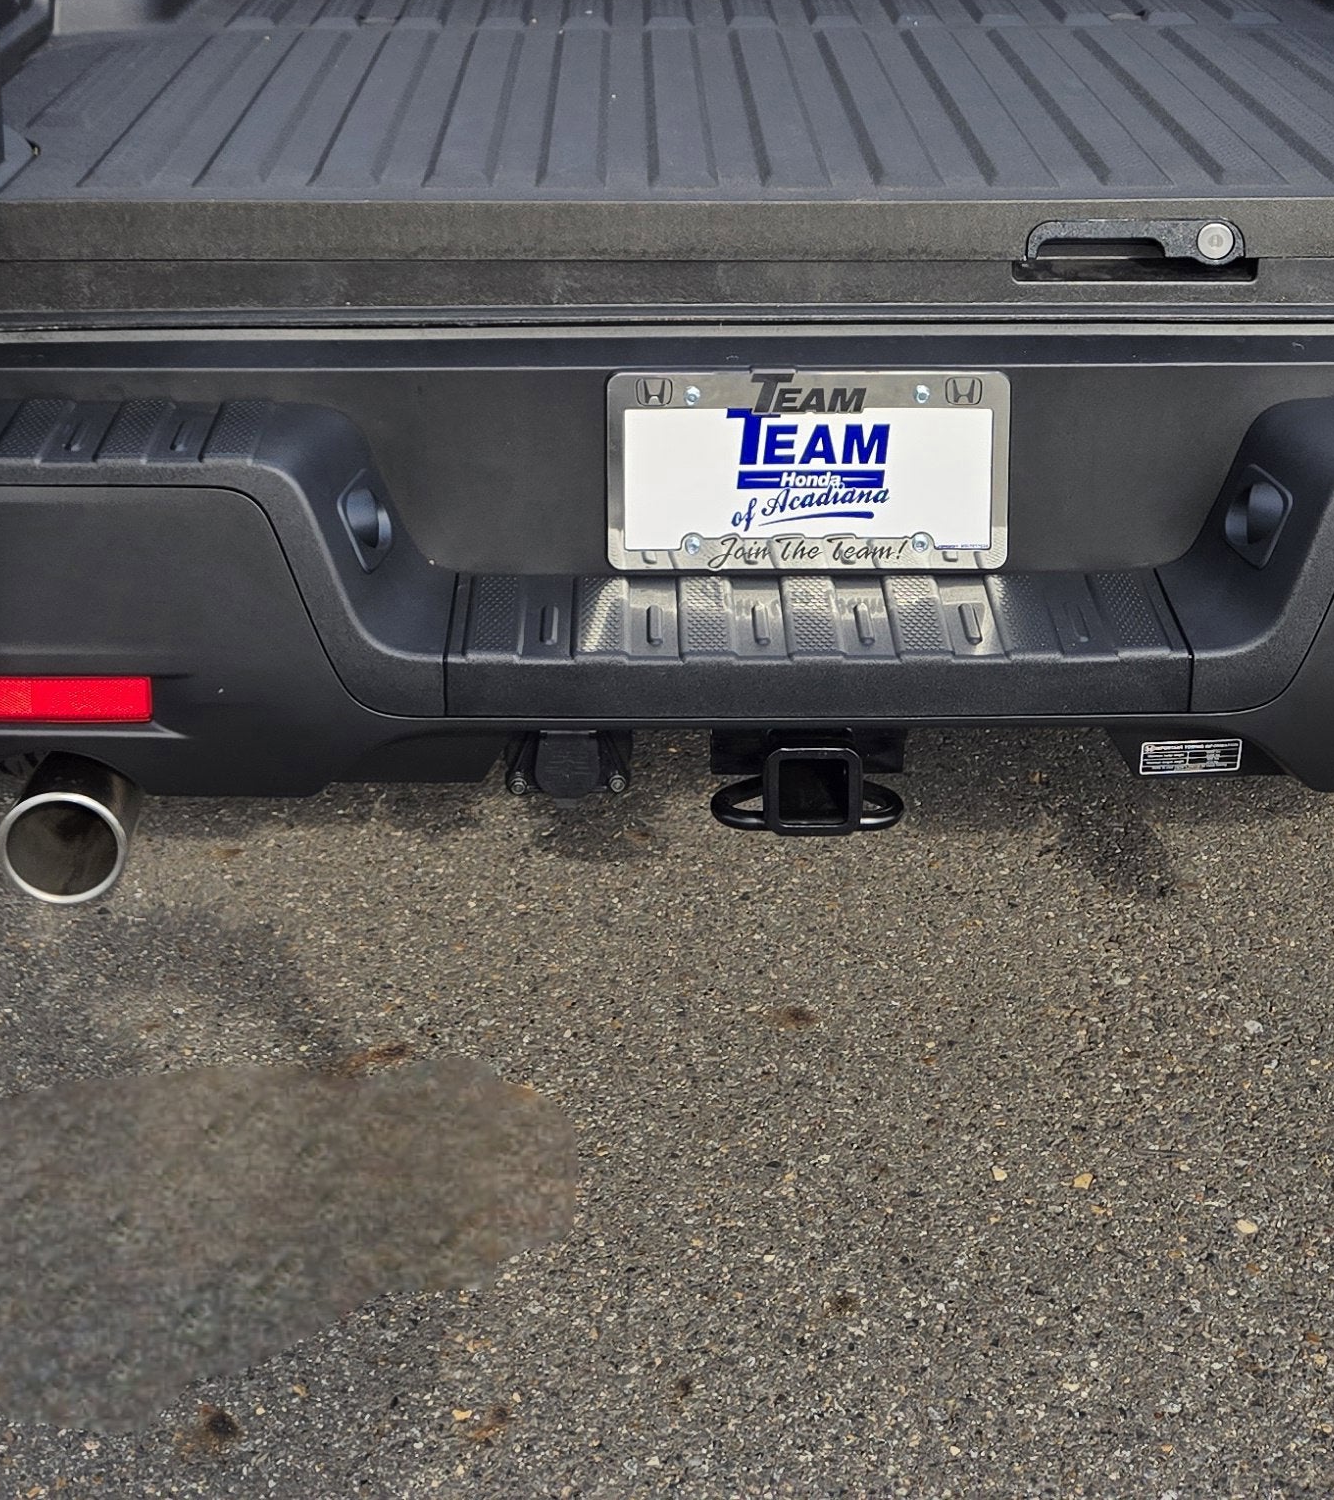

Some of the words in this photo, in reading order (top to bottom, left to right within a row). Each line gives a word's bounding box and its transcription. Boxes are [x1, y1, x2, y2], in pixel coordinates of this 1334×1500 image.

[751, 372, 867, 413] TEAM
[726, 407, 890, 465] TEAM
[779, 471, 842, 488] Honda
[731, 497, 758, 532] of
[761, 483, 890, 517] Acadiana
[707, 536, 771, 569] Join
[774, 536, 822, 560] The
[826, 536, 909, 560] Team!
